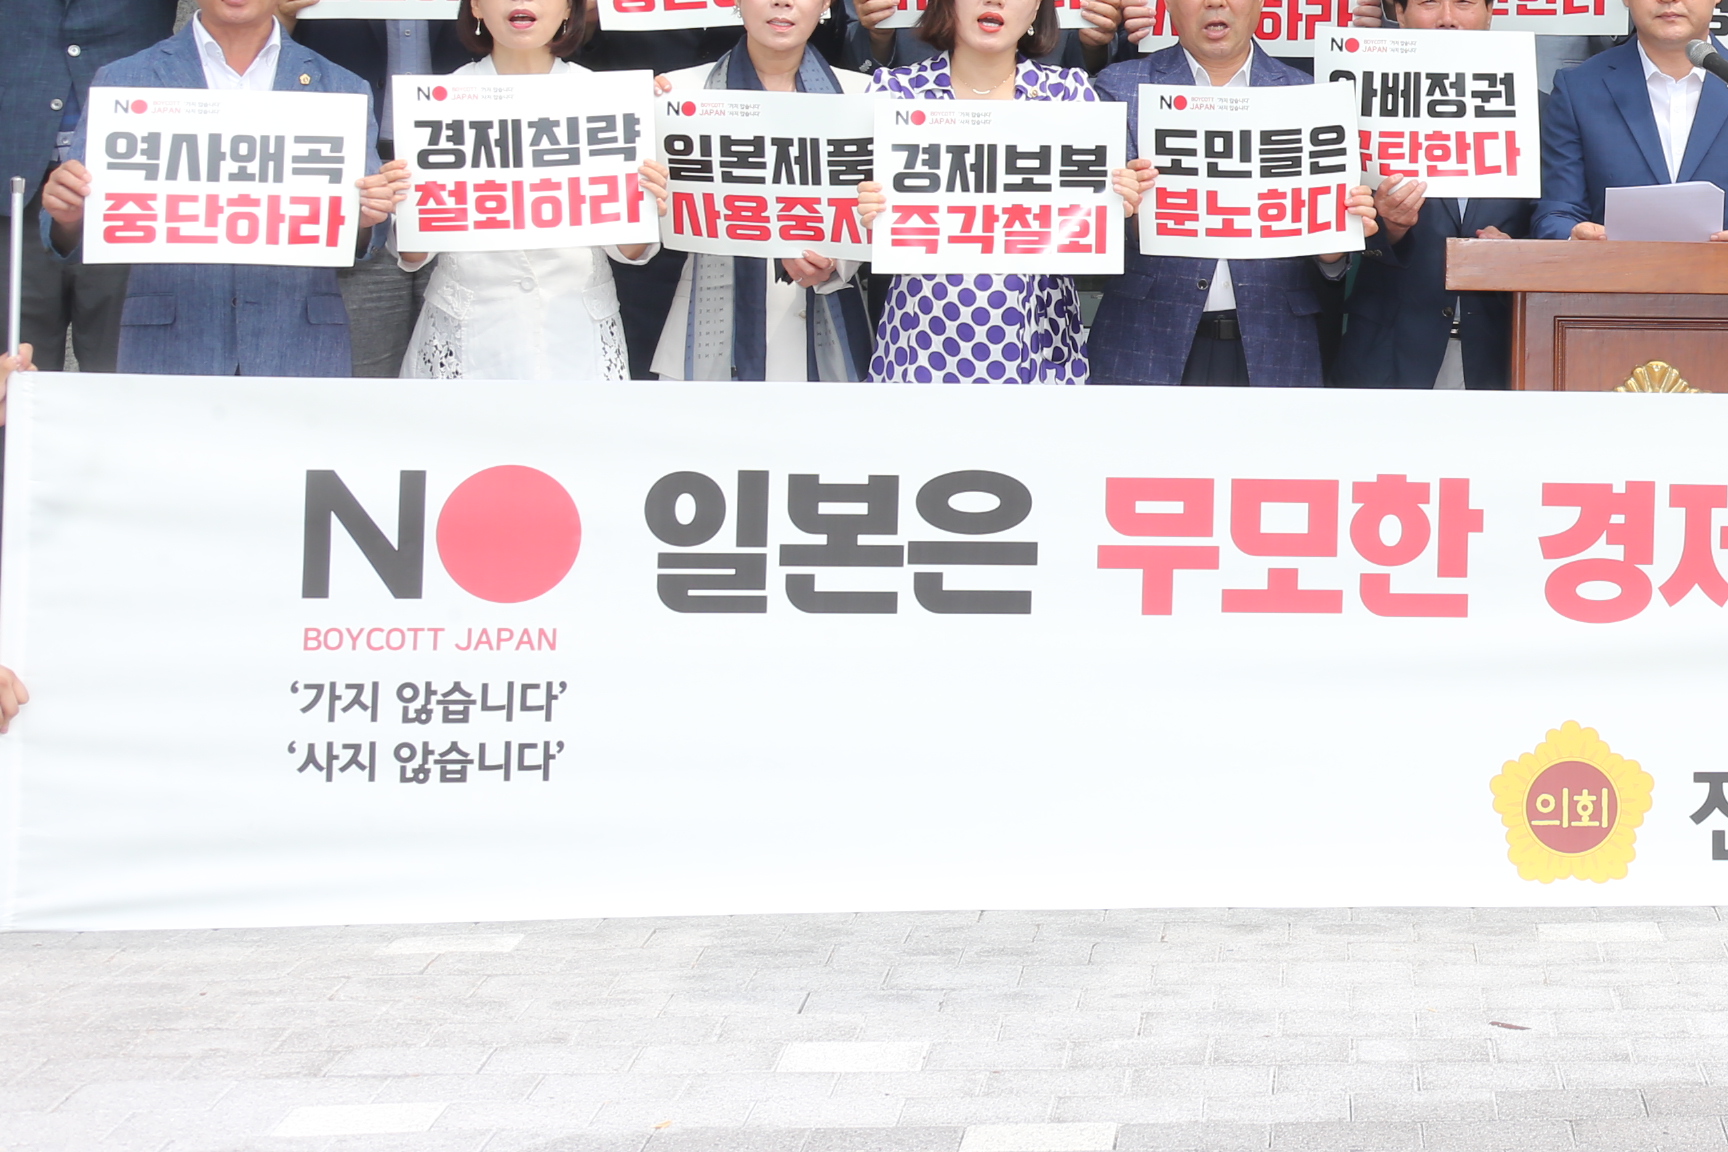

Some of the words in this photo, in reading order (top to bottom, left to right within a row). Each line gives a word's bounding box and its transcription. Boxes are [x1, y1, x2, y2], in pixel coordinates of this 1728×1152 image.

[1329, 69, 1516, 118] 아베정권
[105, 131, 346, 184] 역사왜곡
[414, 112, 641, 170] 경제침략
[664, 134, 874, 186] 일본제품
[1154, 124, 1347, 179] 도민들은
[891, 143, 1108, 194] 경제보복
[102, 192, 346, 248] 중단하라
[414, 173, 645, 232] 철회하라
[890, 204, 1107, 254] 즉각철회
[1155, 183, 1348, 239] 분노한다
[643, 469, 1039, 615] 일본은
[1096, 473, 1485, 618] 무모한
[302, 627, 446, 651] BOYCOTT
[454, 627, 558, 651] JAPAN
[1531, 786, 1610, 830] 의회
